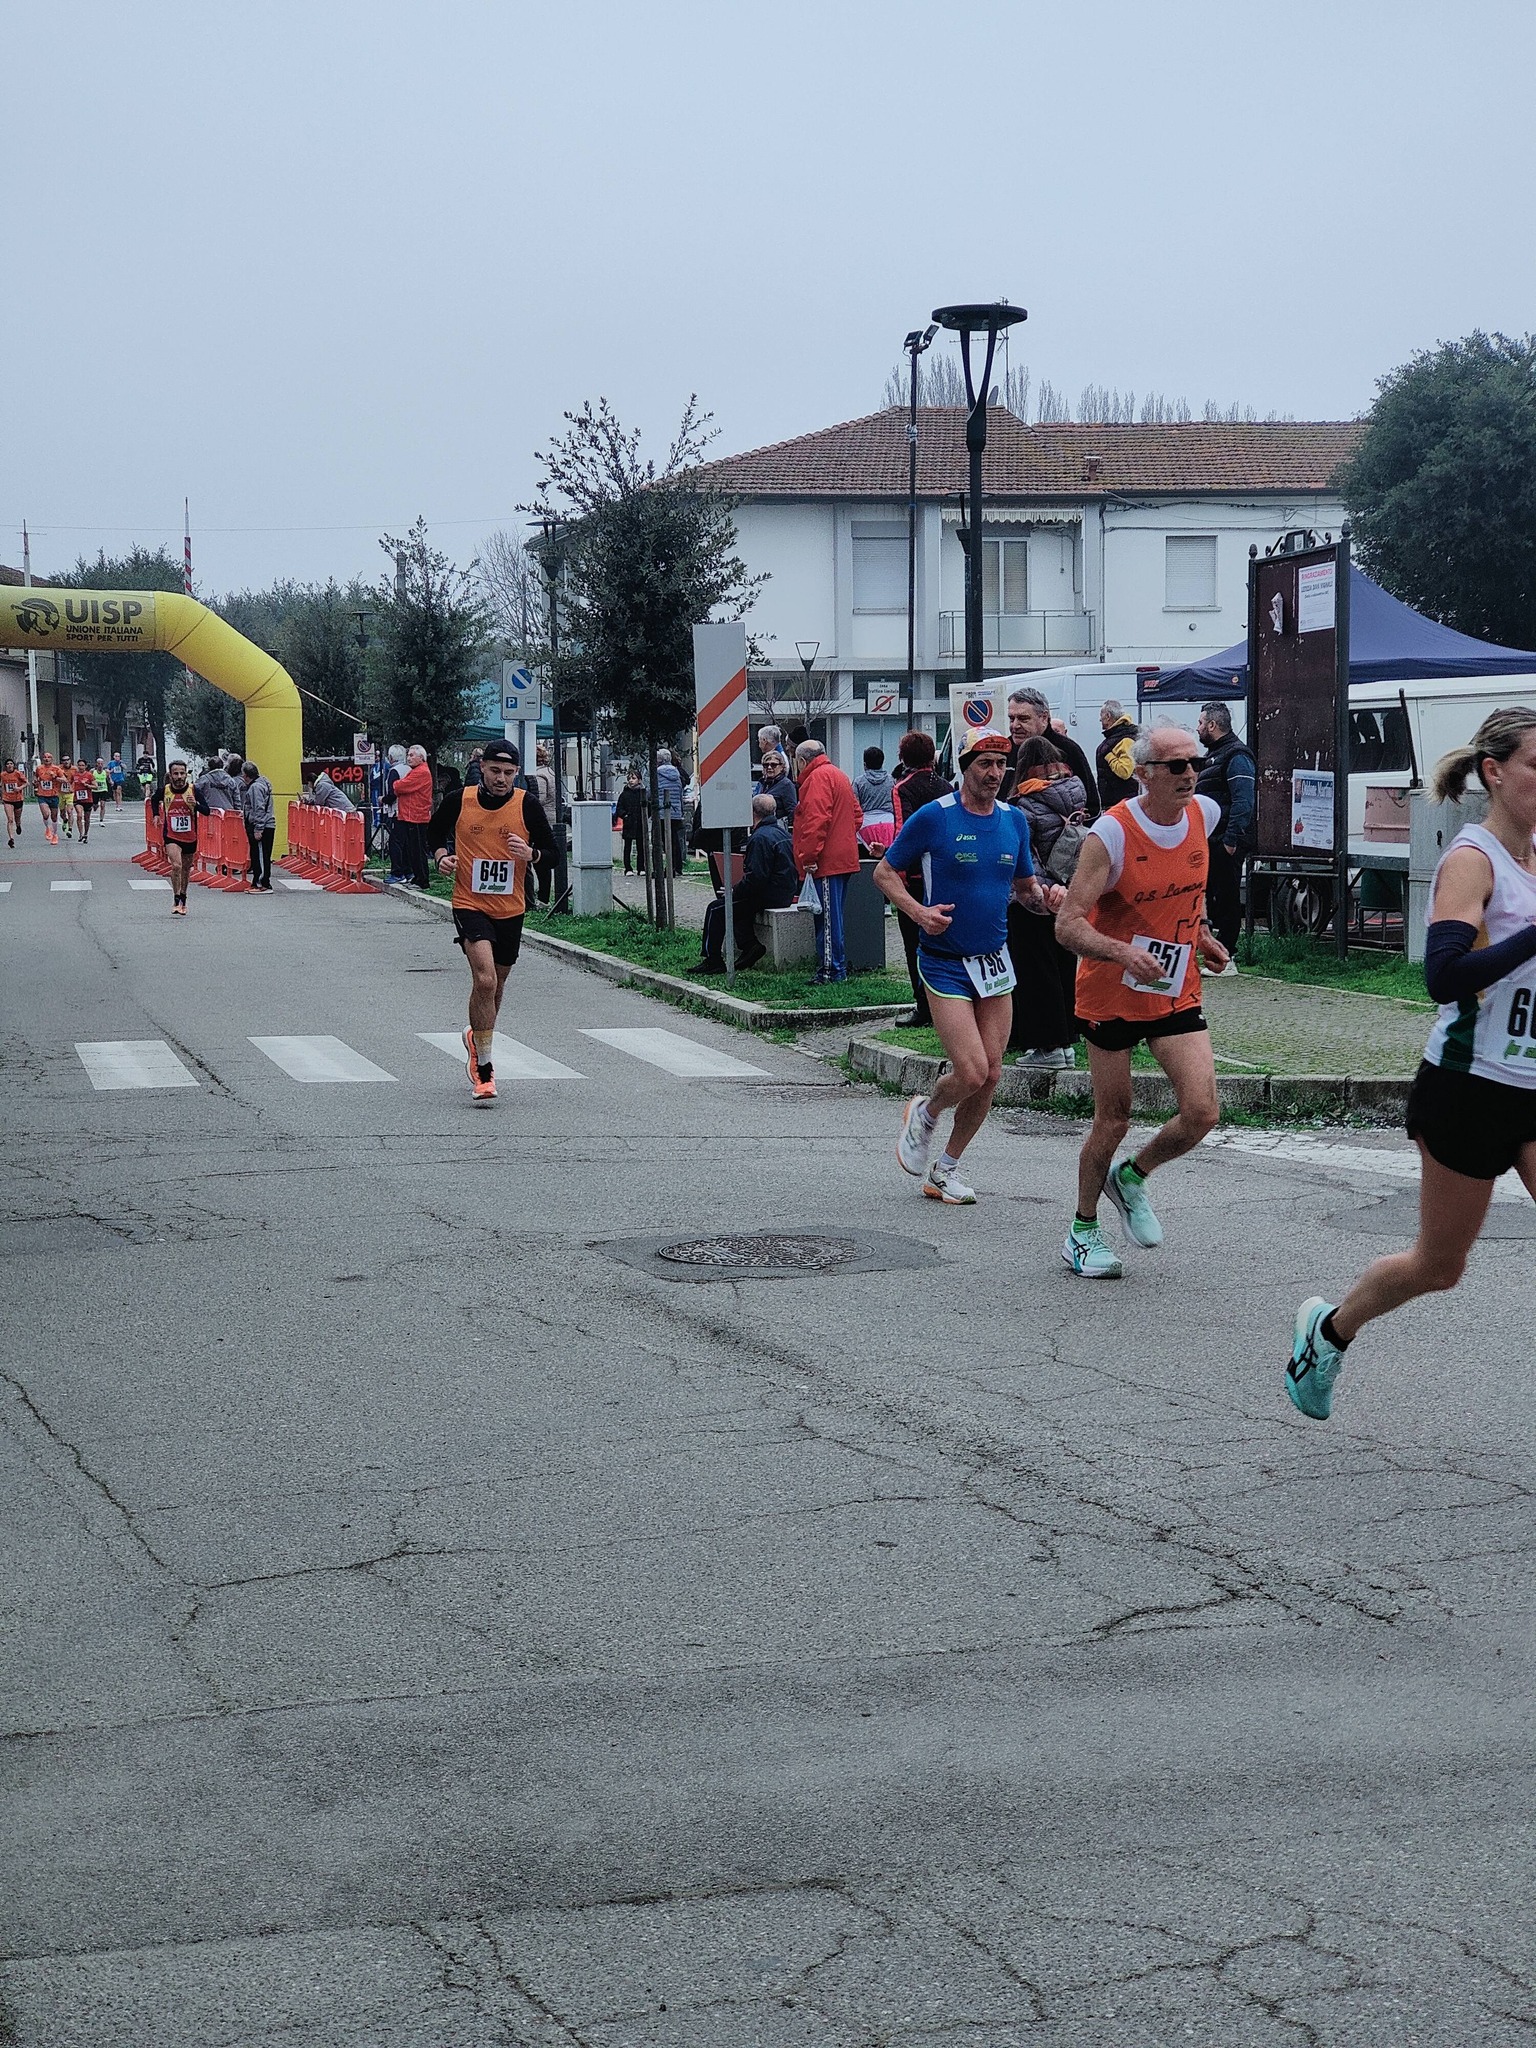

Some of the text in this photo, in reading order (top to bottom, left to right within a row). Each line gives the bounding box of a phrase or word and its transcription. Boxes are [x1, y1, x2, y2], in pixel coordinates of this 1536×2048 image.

[65, 598, 143, 625] UISP
[65, 625, 143, 635] UNIONE ITALIANA
[507, 698, 516, 707] P
[176, 817, 189, 827] 735
[480, 861, 508, 883] 645
[1508, 988, 1536, 1039] 6
